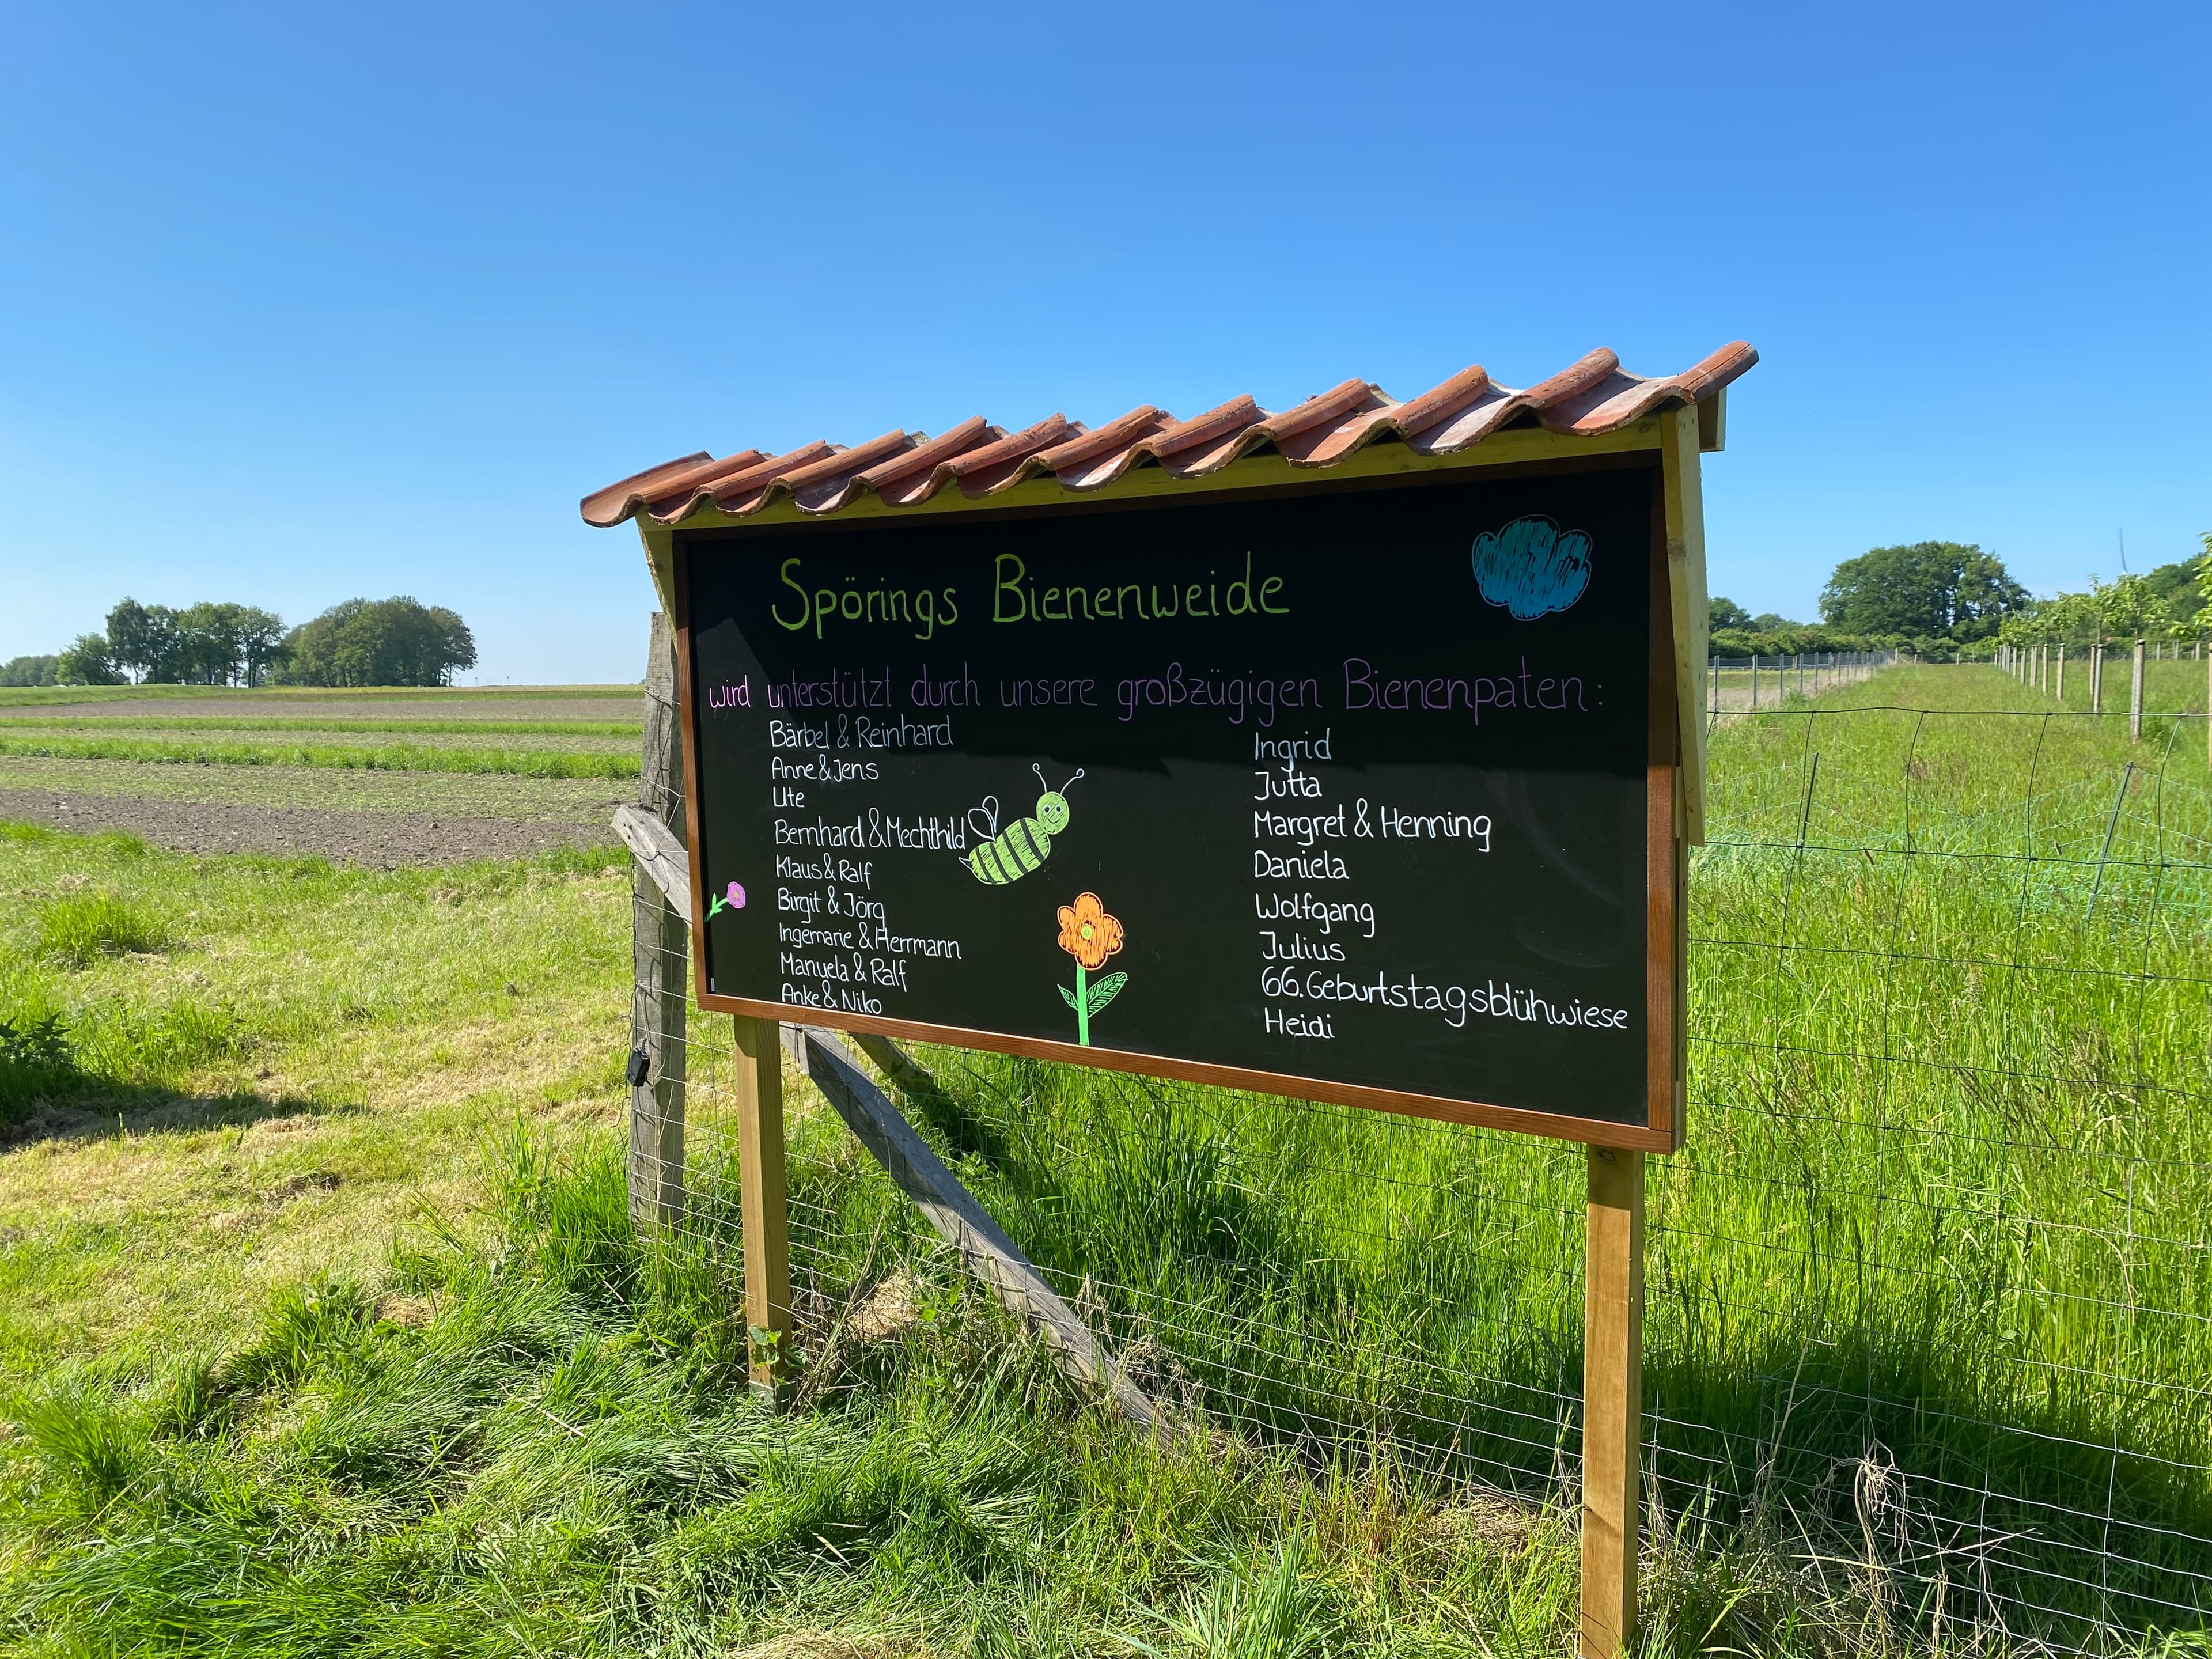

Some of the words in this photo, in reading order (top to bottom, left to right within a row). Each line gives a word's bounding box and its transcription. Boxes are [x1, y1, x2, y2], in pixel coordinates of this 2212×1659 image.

[771, 557, 958, 639] Spörings
[993, 551, 1290, 622] Bienenweide
[709, 673, 751, 708] wird
[767, 666, 892, 708] unterstützt
[911, 661, 981, 706] durch
[1001, 679, 1097, 707] unsere
[1117, 662, 1323, 726] großzügigen
[1343, 655, 1603, 726] Bienenpaten:
[770, 719, 830, 749] Bärbel
[837, 714, 850, 749] &
[855, 714, 954, 747] Reinhard
[1255, 727, 1332, 772] Ingrid
[772, 786, 805, 808] Ute
[1253, 771, 1323, 801] Jutta
[774, 815, 864, 848] Bernhard
[1254, 803, 1348, 846] Margret
[1354, 797, 1374, 838] &
[1381, 805, 1492, 853] Henning
[1253, 849, 1350, 880] Daniela
[778, 887, 821, 924] Birgit
[827, 885, 840, 915] &
[843, 892, 886, 933] Jörg
[1255, 892, 1374, 938] Wolfgang
[779, 922, 855, 950] Ingemarie
[1259, 930, 1346, 962] Julius
[780, 951, 850, 982] Manuela
[854, 952, 868, 982] &
[869, 957, 908, 993] Ralf
[781, 983, 821, 1007] Anke
[840, 988, 883, 1015] Niko
[1264, 1006, 1336, 1039] Heidi
